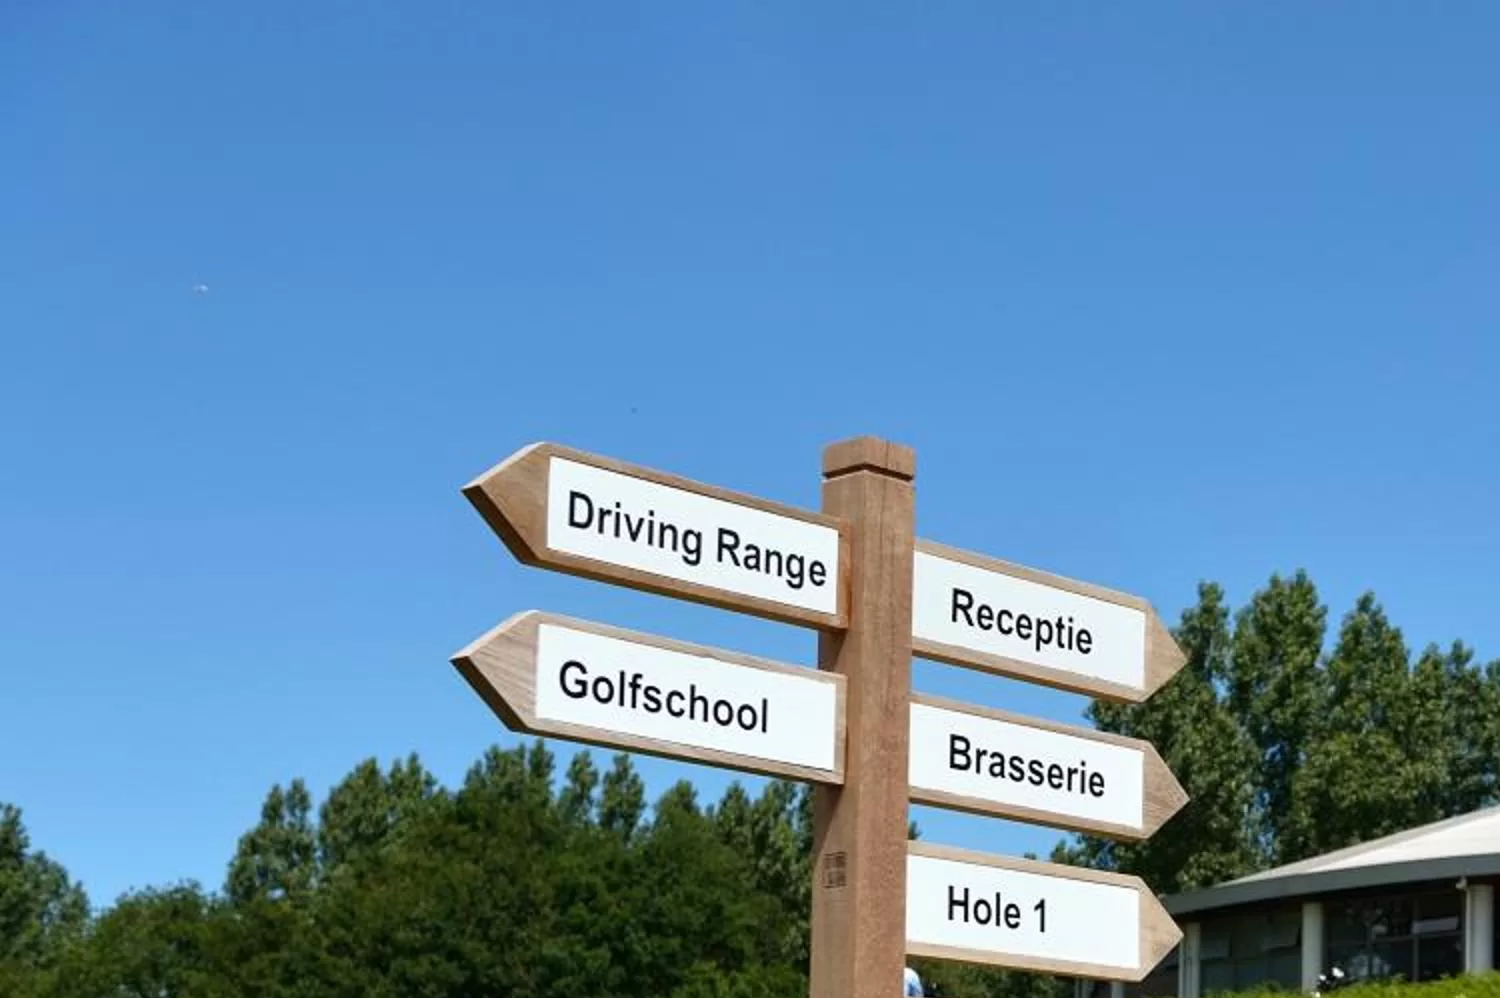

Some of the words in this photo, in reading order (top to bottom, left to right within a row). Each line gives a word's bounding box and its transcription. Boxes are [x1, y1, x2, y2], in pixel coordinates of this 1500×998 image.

[568, 490, 702, 567] Driving
[717, 527, 827, 590] Range
[951, 587, 1093, 656] Receptie
[559, 660, 768, 734] Golfschool
[949, 733, 1105, 798] Brasserie
[947, 885, 1021, 930] Hole
[1033, 898, 1046, 933] 1
